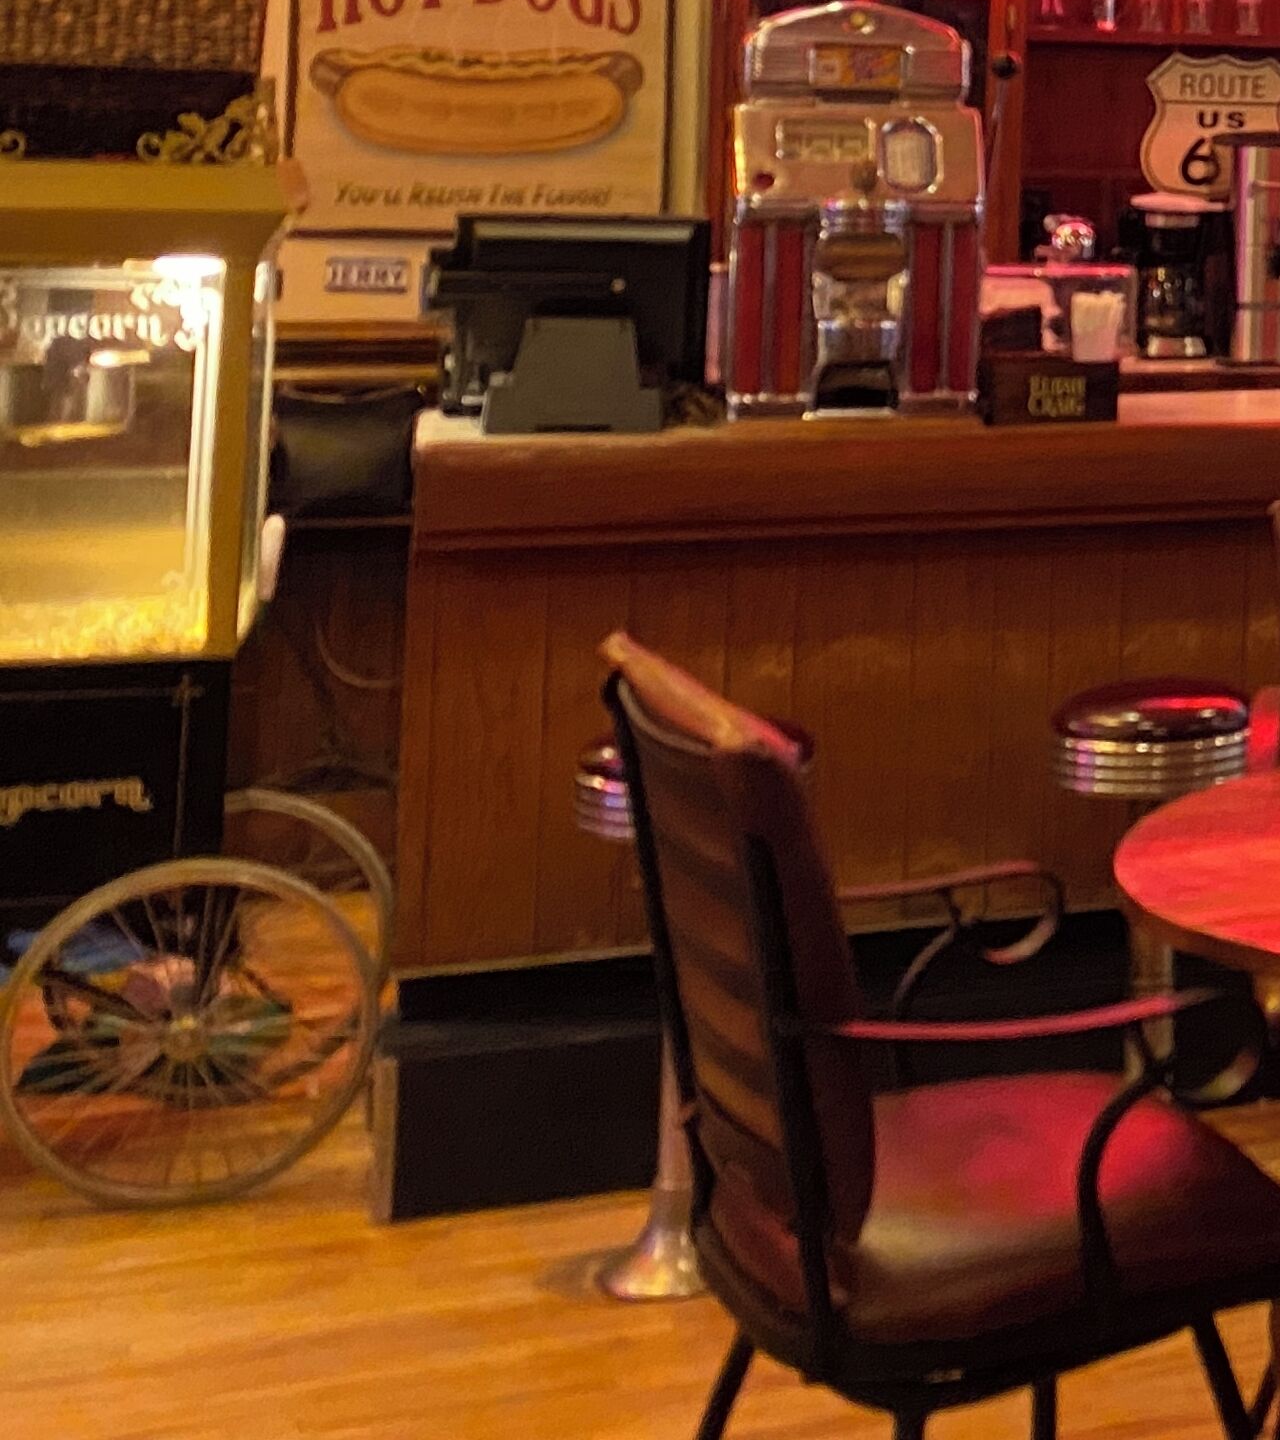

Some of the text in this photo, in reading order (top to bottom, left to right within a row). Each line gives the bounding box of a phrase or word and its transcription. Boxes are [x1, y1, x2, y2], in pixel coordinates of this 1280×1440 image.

[1178, 72, 1267, 99] ROUTE
[1197, 110, 1245, 129] US
[1181, 136, 1221, 186] 6
